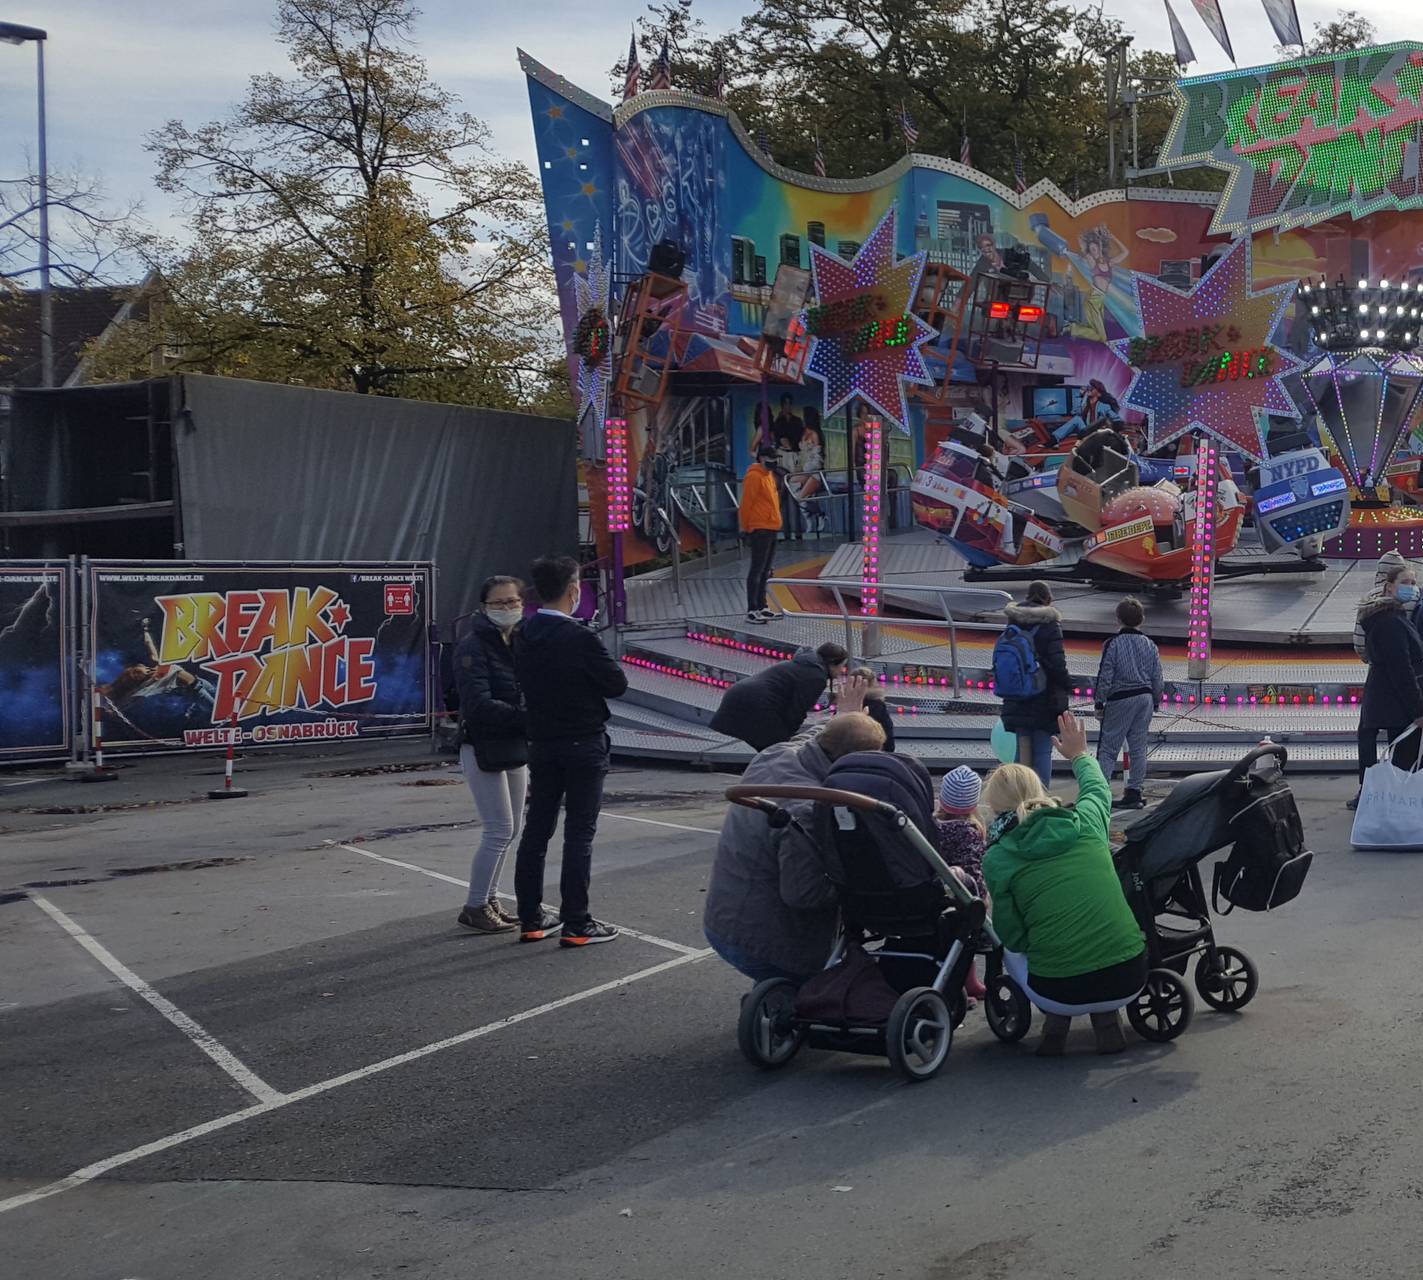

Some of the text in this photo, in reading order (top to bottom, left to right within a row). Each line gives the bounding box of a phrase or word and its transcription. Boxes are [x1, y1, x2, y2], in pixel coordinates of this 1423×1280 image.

[1183, 53, 1396, 156] BREAK
[1271, 456, 1320, 482] NYPD
[1107, 528, 1129, 542] FIRE
[154, 585, 339, 665] BREAK
[201, 635, 377, 723] DANCE
